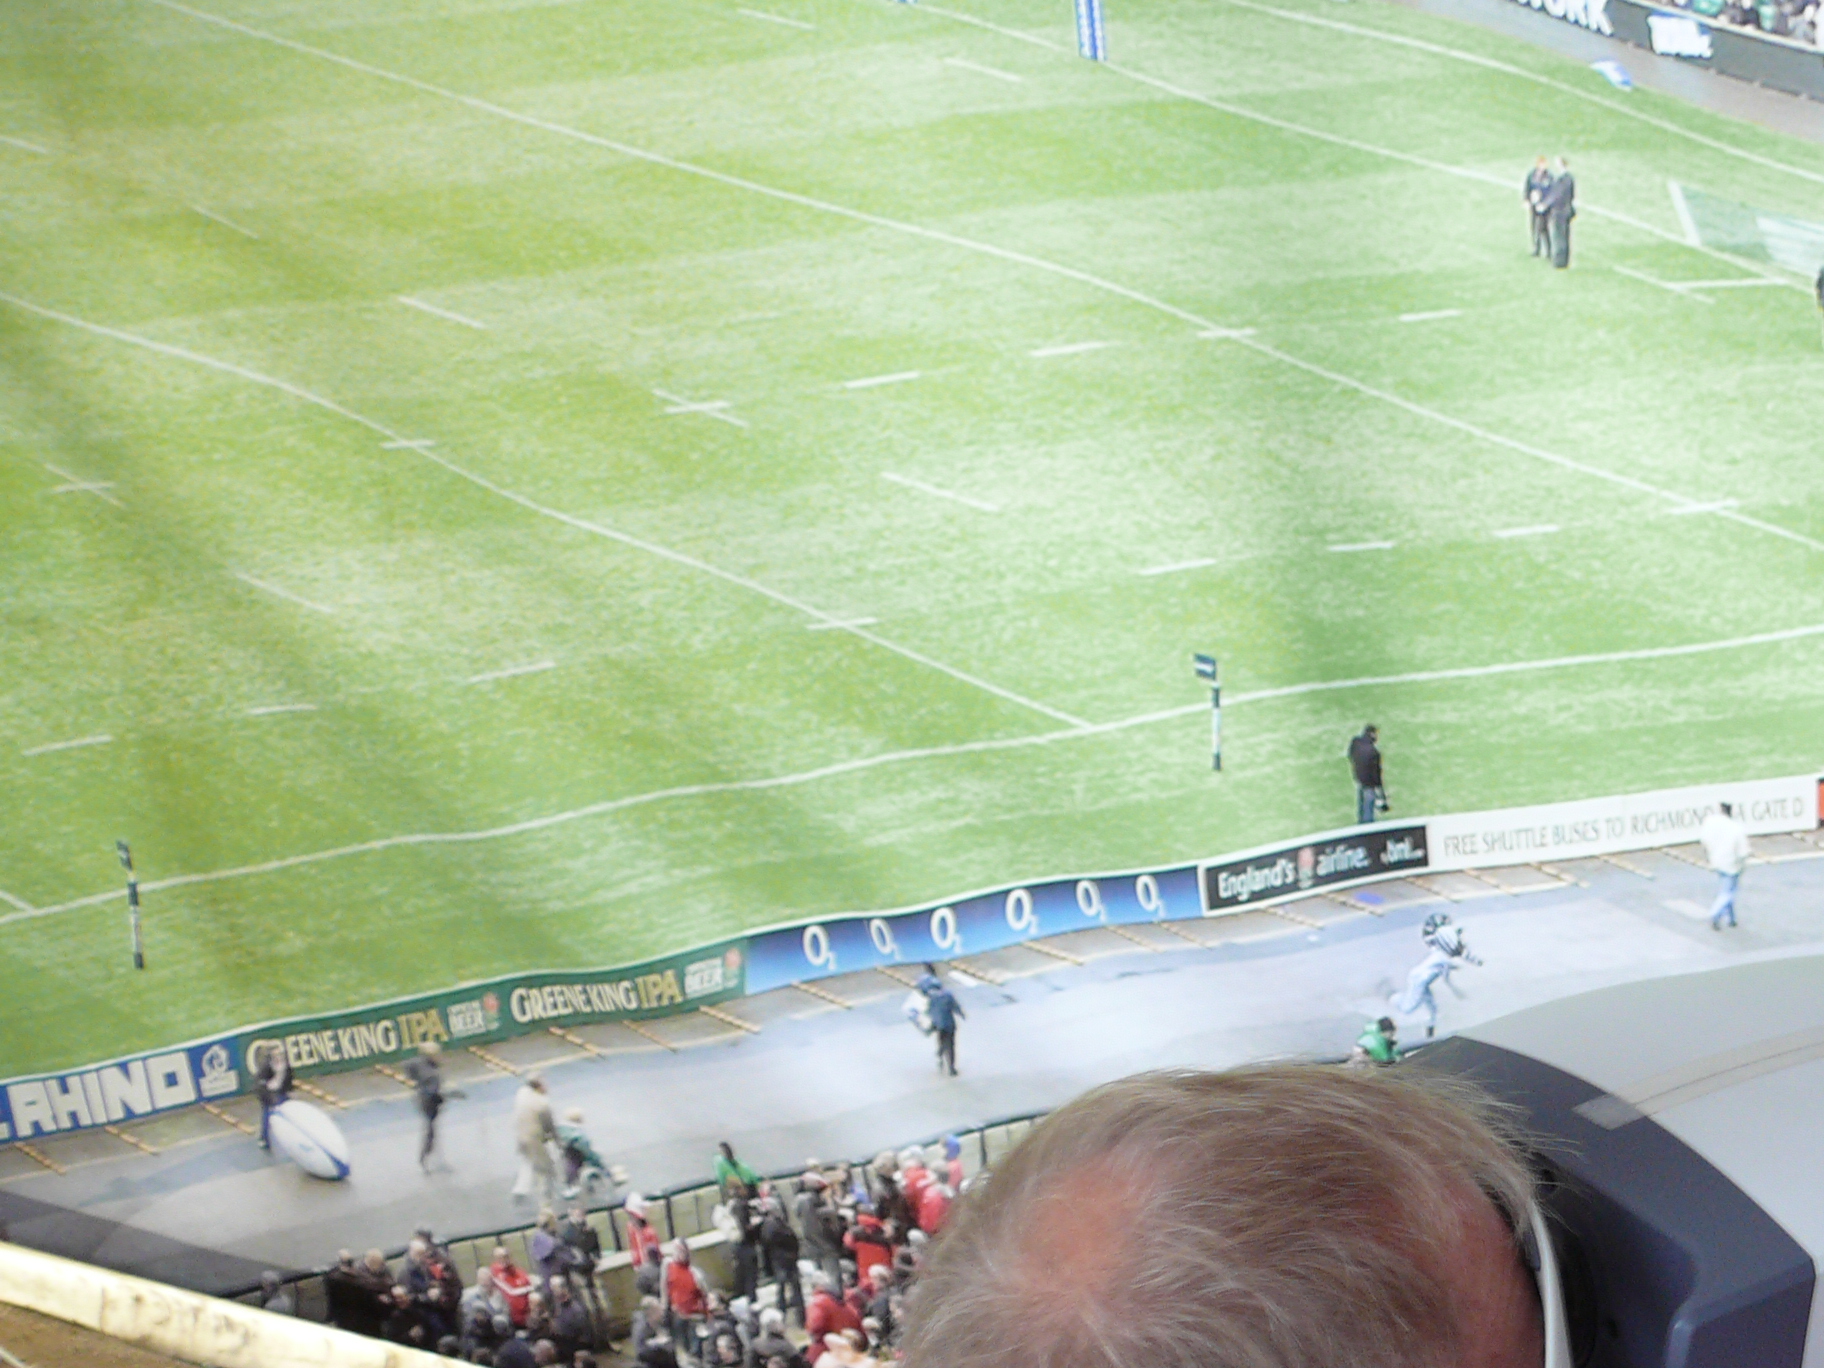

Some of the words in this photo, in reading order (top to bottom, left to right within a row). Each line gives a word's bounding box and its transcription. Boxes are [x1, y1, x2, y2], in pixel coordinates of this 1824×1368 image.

[1444, 833, 1478, 857] FREE
[1483, 825, 1548, 854] SHUTTLE
[1552, 819, 1599, 846] BUSES
[1605, 816, 1625, 840] TO
[1217, 857, 1297, 902] England's
[511, 983, 588, 1024] GREENE
[587, 979, 638, 1013] KING
[636, 968, 684, 1010] IPA
[246, 1025, 340, 1076] GEENE
[337, 1018, 399, 1060] KING
[397, 1008, 449, 1050] IPA
[7, 1051, 198, 1139] RHINO
